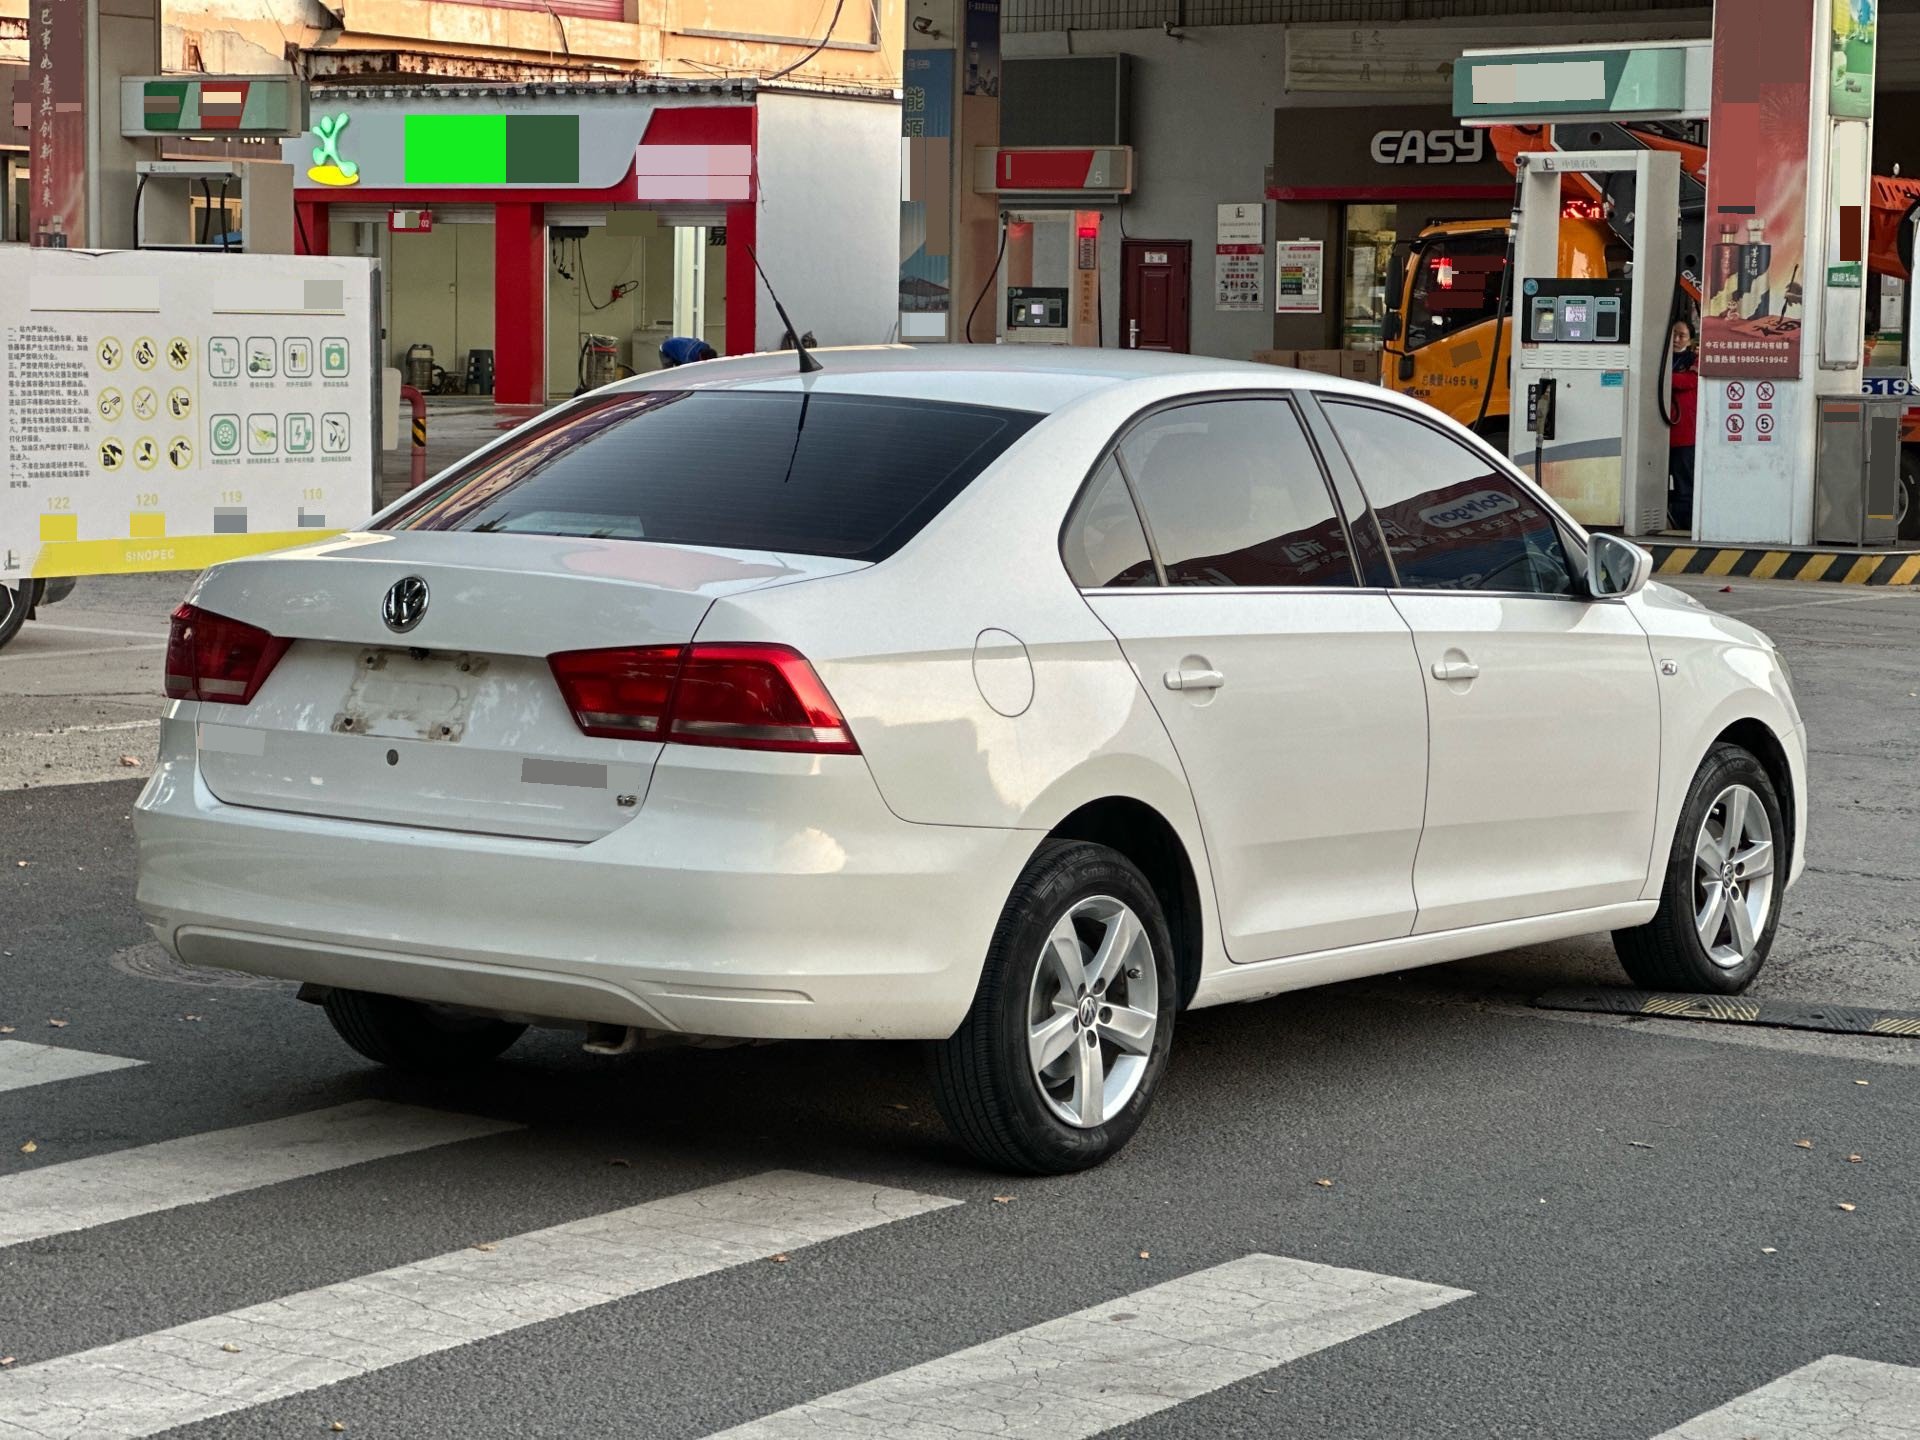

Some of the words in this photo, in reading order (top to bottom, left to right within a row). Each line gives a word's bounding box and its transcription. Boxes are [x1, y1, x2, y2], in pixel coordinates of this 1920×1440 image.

[1370, 130, 1483, 163] EASY
[1760, 417, 1769, 430] 5
[136, 493, 158, 506] 120
[221, 490, 242, 503] 119
[302, 488, 323, 500] 110
[47, 496, 70, 509] 122
[126, 548, 174, 561] SINOPEC
